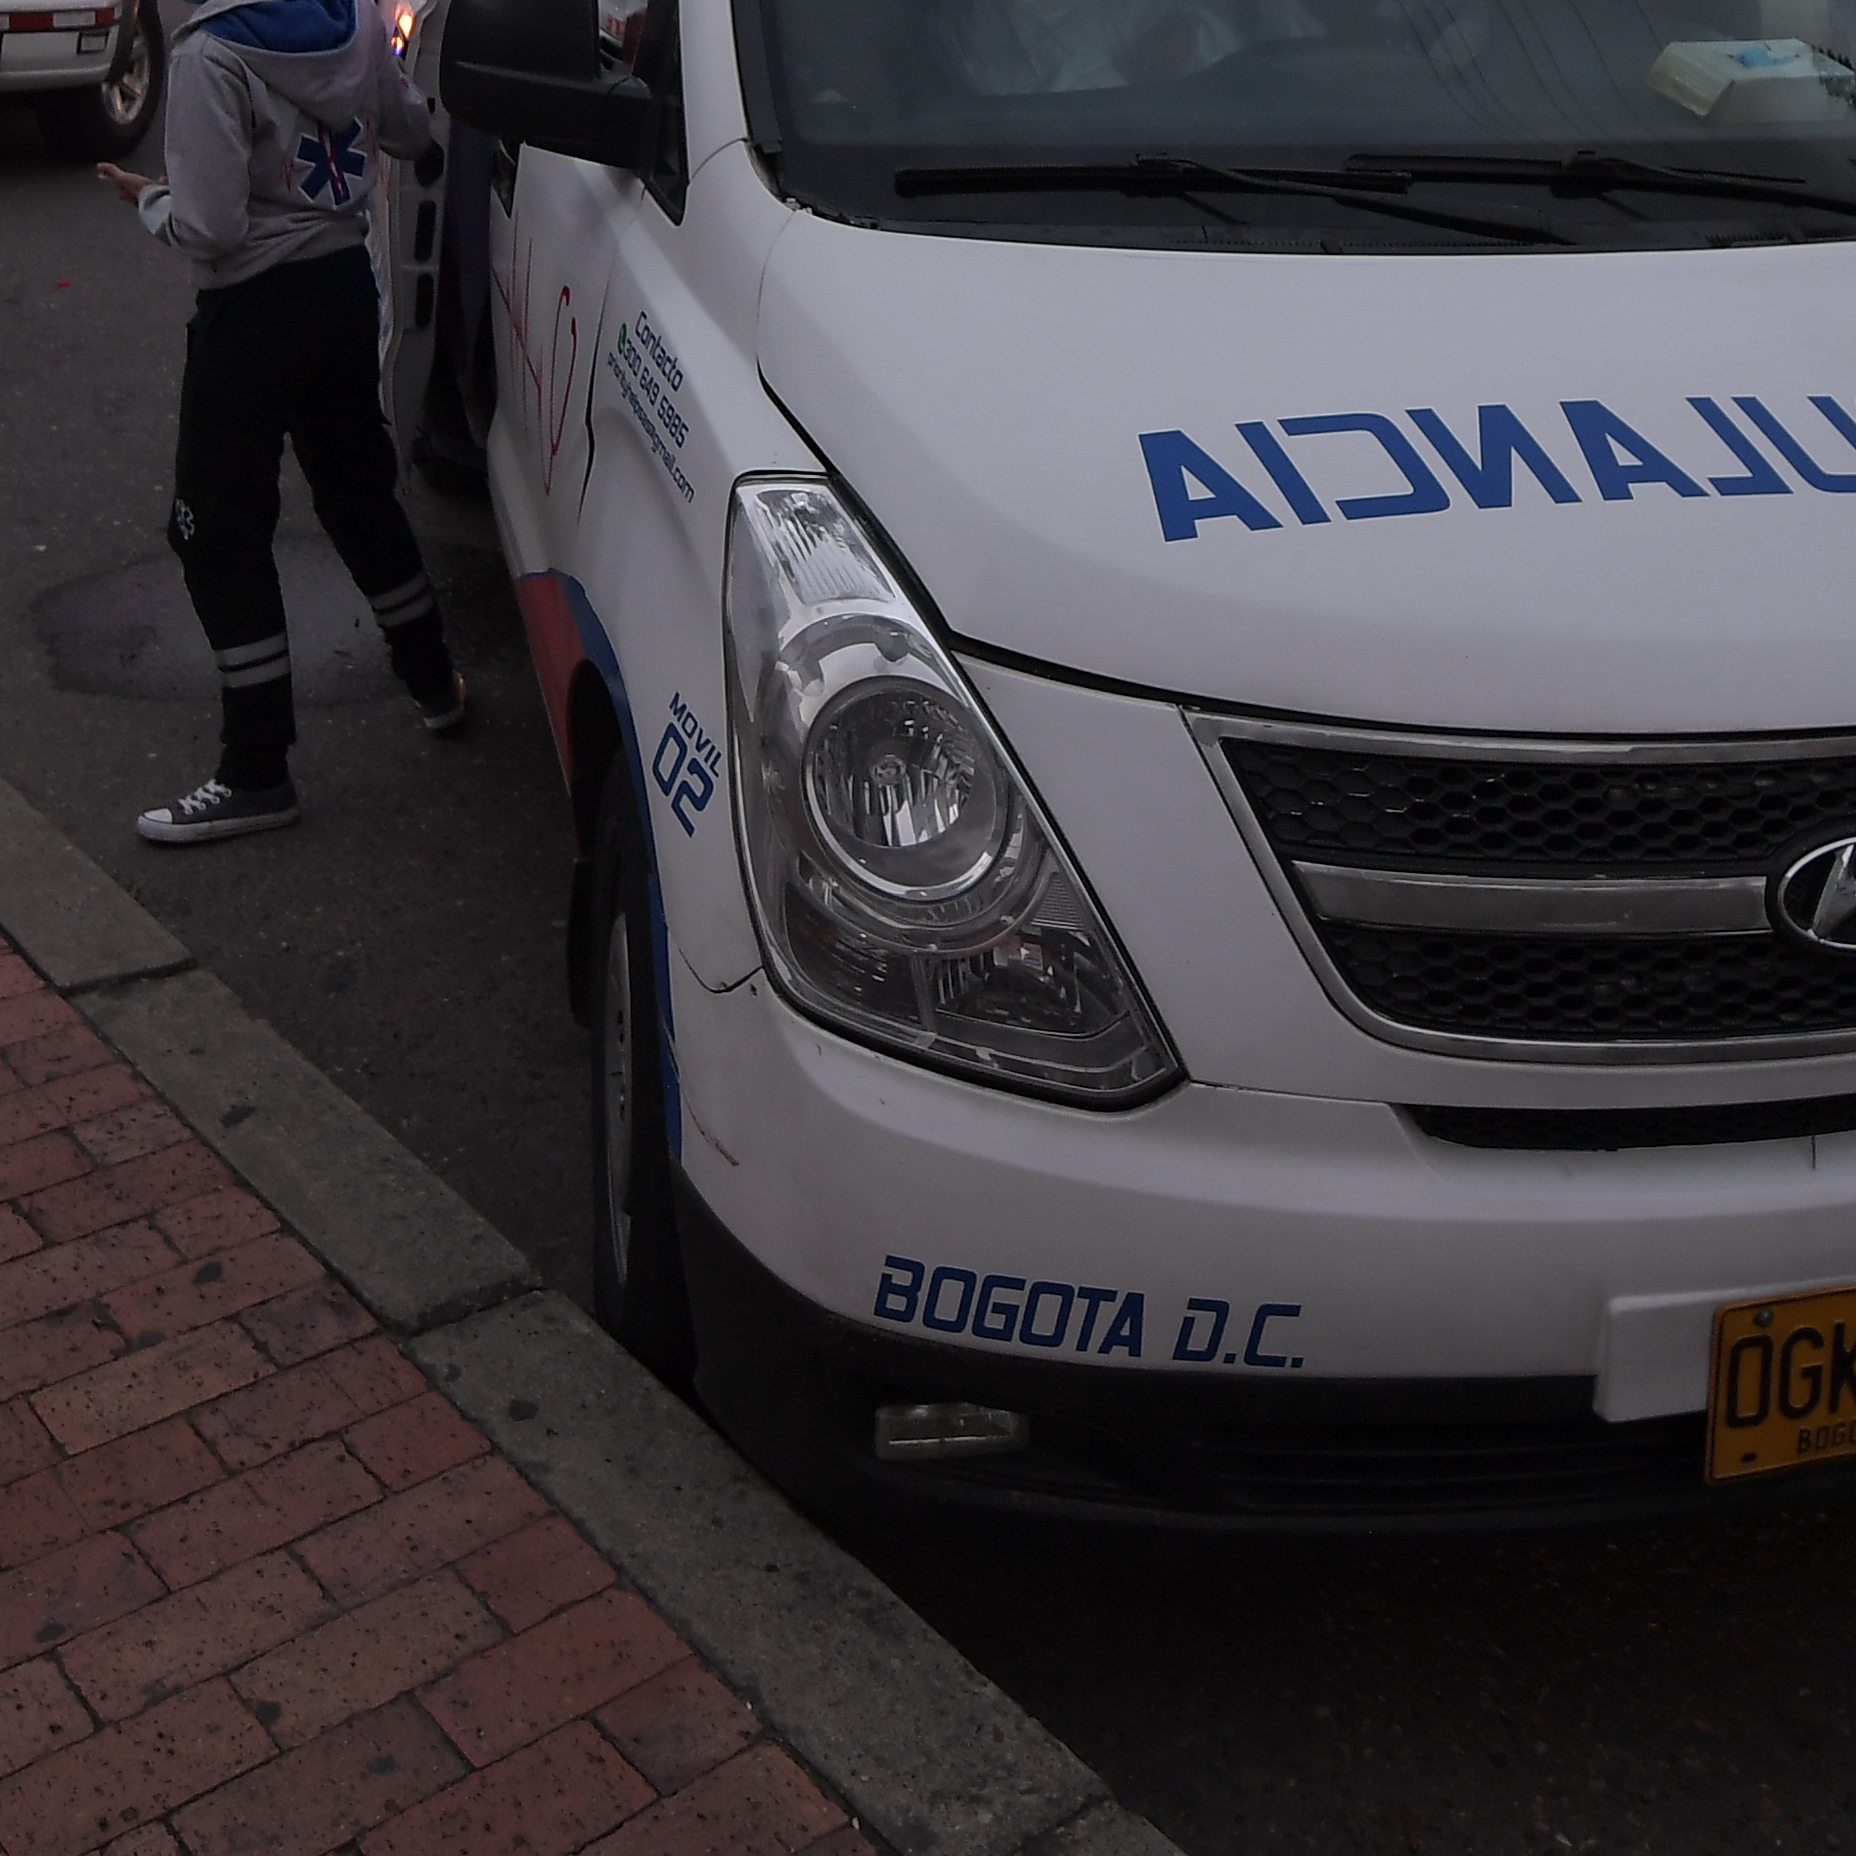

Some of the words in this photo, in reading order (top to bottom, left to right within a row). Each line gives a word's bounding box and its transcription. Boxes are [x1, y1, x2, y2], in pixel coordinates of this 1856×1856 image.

[622, 338, 643, 377] 300
[638, 365, 661, 407] 649
[635, 310, 685, 392] Contacto
[669, 692, 722, 778] MOVIL
[652, 722, 714, 839] 02
[874, 1255, 1145, 1357] BOGOTA
[1172, 1298, 1304, 1368] D.C.
